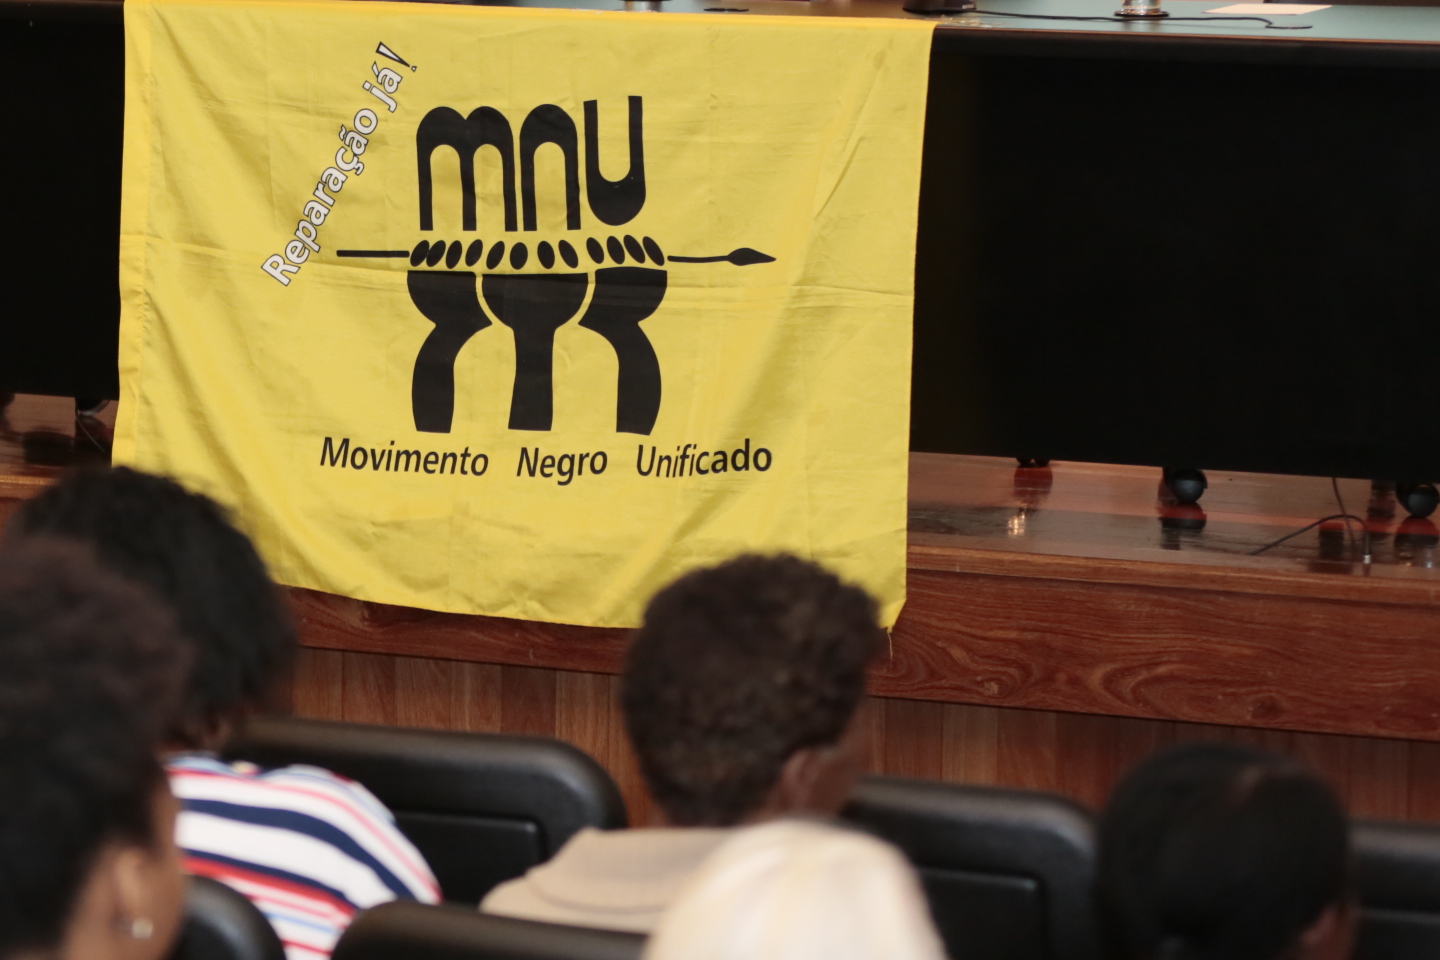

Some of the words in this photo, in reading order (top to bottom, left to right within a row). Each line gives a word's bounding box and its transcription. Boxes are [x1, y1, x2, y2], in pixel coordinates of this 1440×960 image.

[261, 107, 379, 287] Reparação
[362, 41, 418, 113] já!
[320, 436, 489, 477] Movimento
[516, 446, 608, 487] Negro
[636, 438, 773, 479] Unificado
